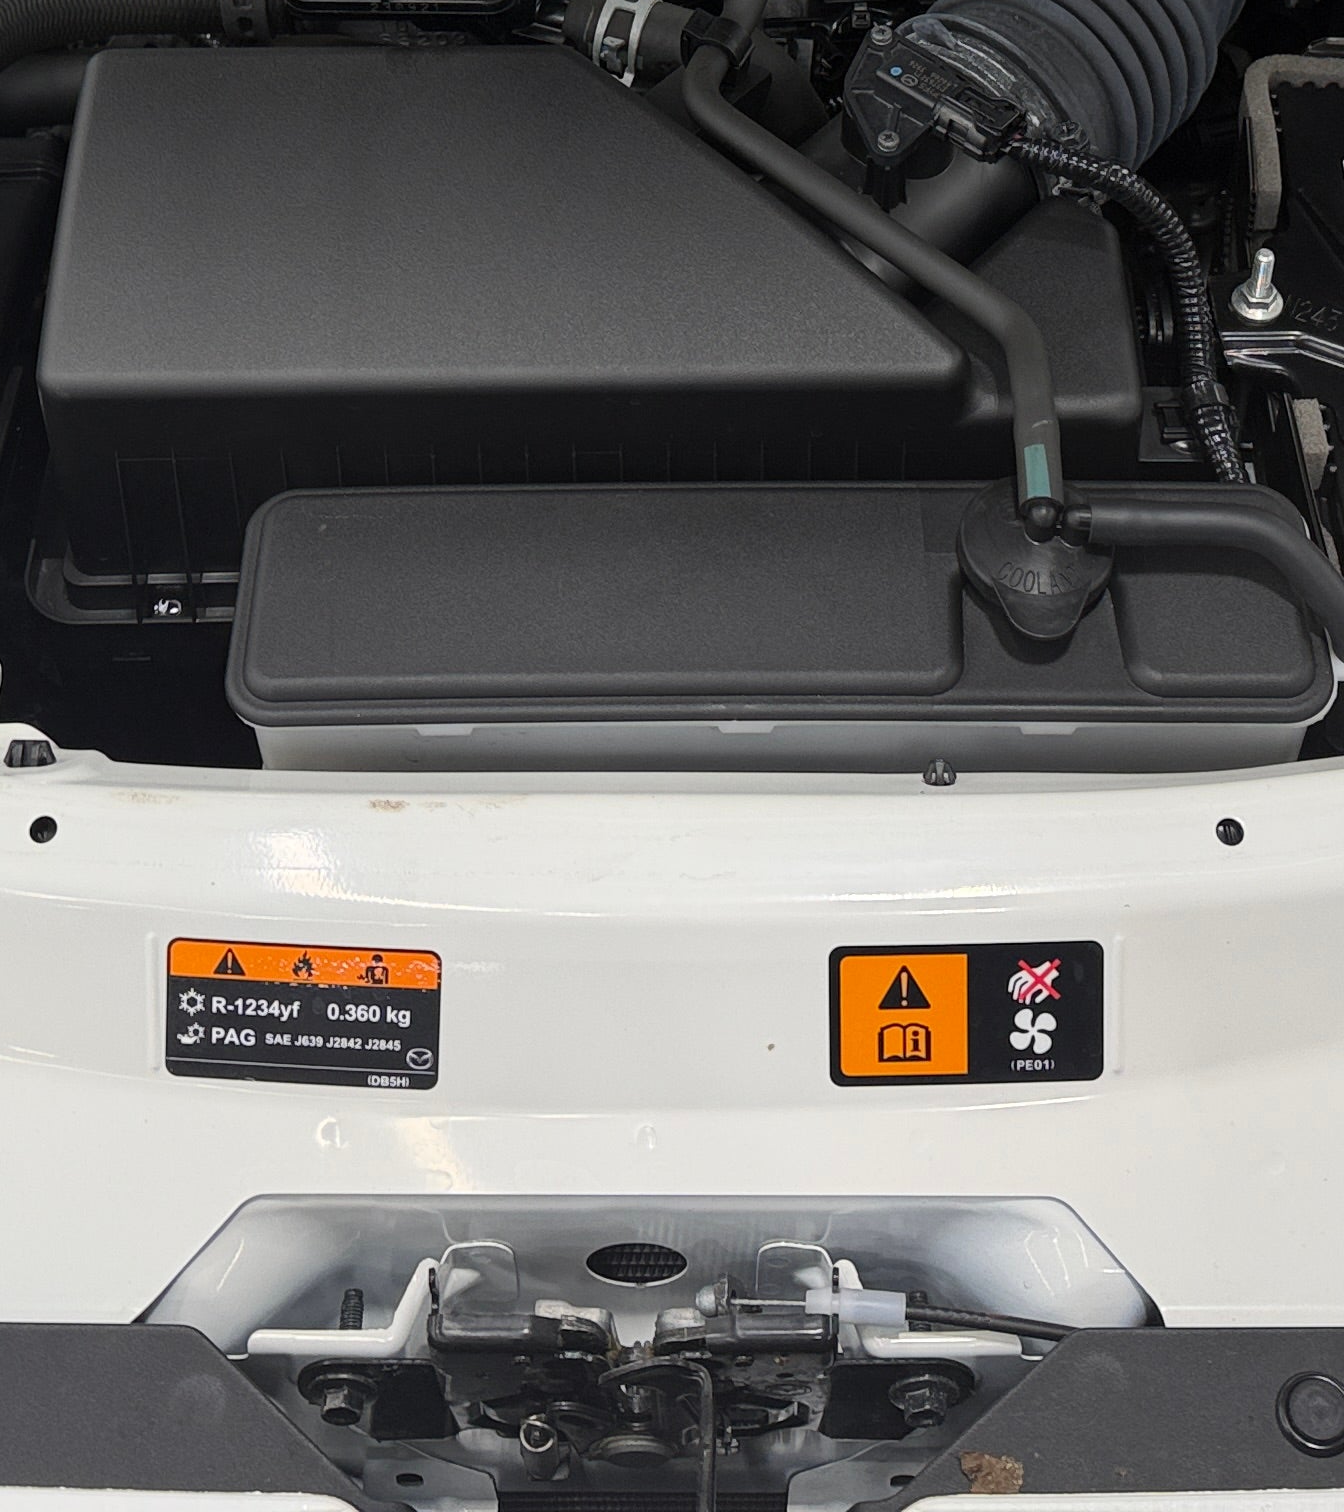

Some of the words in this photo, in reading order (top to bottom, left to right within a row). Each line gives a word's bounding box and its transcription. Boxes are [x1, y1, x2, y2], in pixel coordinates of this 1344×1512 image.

[211, 996, 300, 1019] R-1234yf
[327, 1002, 381, 1022] 0.360
[385, 1005, 411, 1027] kg
[211, 1027, 256, 1046] PAG
[264, 1033, 292, 1046] SAE
[294, 1034, 324, 1047] J639
[325, 1037, 363, 1049] J2842
[364, 1038, 401, 1051] J2845
[1011, 1059, 1055, 1071] (PE01)
[367, 1075, 410, 1088] (DB5H)
